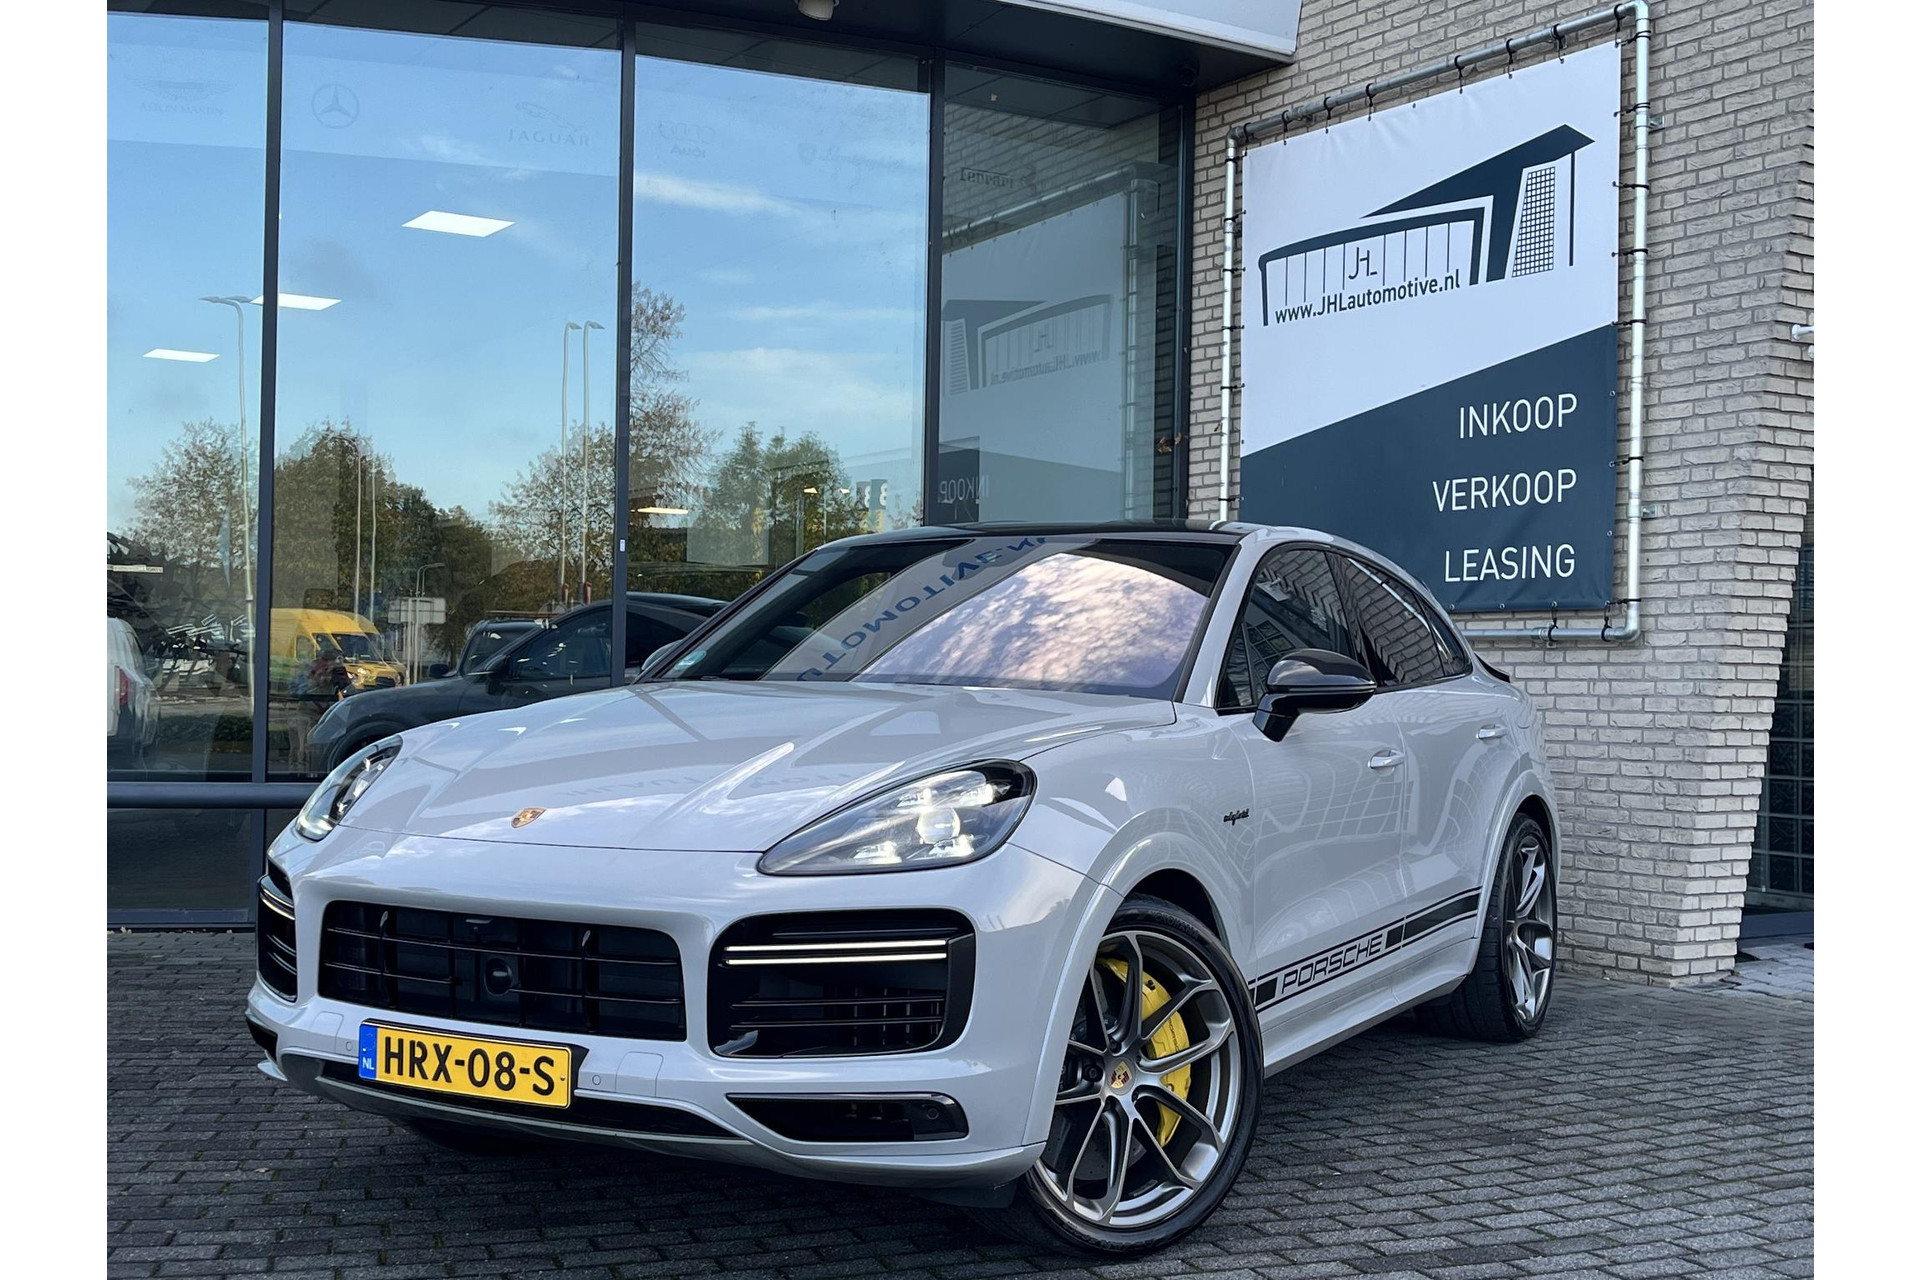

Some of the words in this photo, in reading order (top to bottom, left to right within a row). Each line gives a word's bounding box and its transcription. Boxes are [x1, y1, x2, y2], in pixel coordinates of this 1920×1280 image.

[507, 127, 590, 148] JAGUAR
[1275, 268, 1461, 324] www.JHLautomotive.nl
[1459, 392, 1578, 439] INKOOP
[1432, 468, 1578, 512] VERKOOP
[1444, 543, 1576, 582] LEASING
[1281, 933, 1383, 995] PORSCHE
[362, 1057, 375, 1071] NL
[384, 1036, 555, 1096] HRX-08-S
